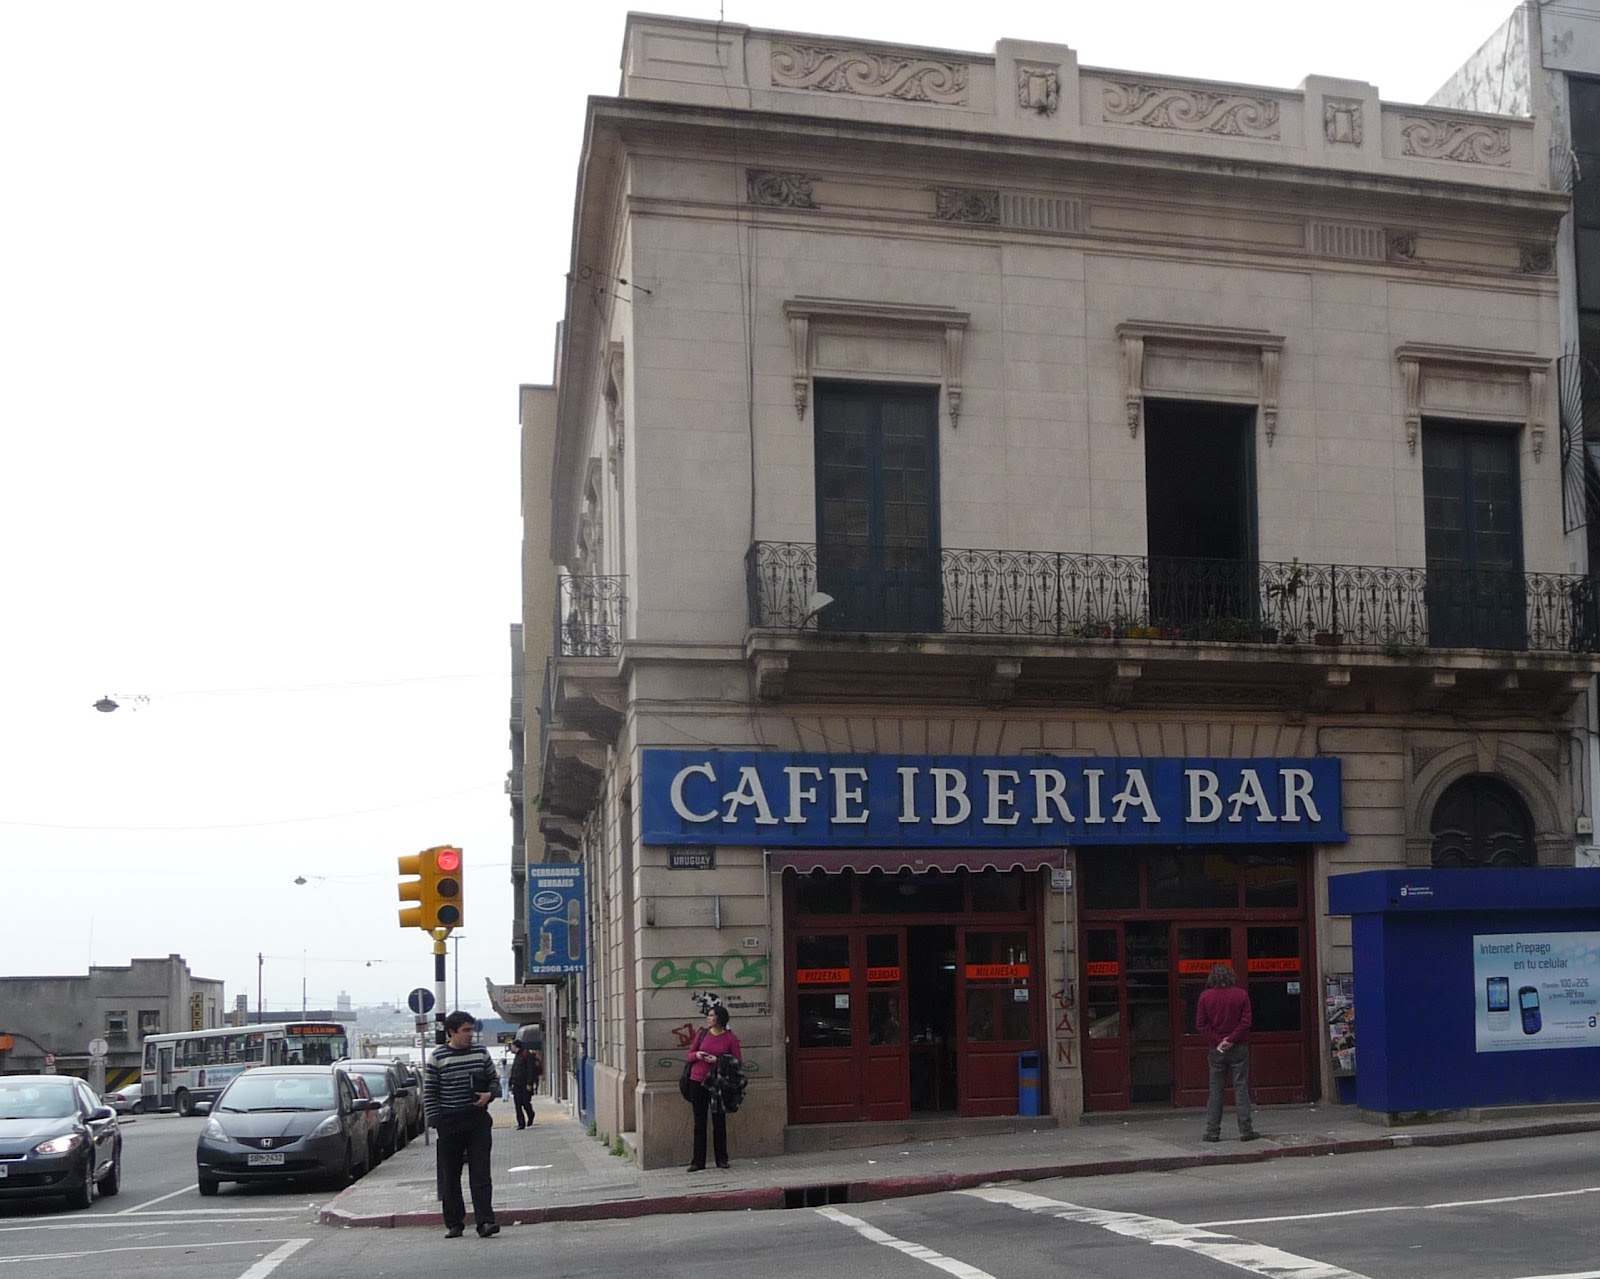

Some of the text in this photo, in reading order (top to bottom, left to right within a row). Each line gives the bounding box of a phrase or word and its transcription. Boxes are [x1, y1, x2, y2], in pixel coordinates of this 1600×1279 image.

[670, 761, 1322, 825] CAFE IBERIA BAR
[673, 856, 711, 865] URUGUAY
[531, 868, 580, 877] CERRADURAS
[538, 879, 574, 887] HERRAJES
[1480, 942, 1551, 955] Internet Prepago
[541, 965, 562, 973] 2908
[1088, 962, 1117, 974] PIZZETAS
[1251, 960, 1296, 969] SANDWICHES
[1513, 958, 1569, 970] en tu celular
[805, 970, 842, 981] PIZZETAS
[868, 969, 899, 980] BEBIDAS
[975, 966, 1019, 977] MILANESAS
